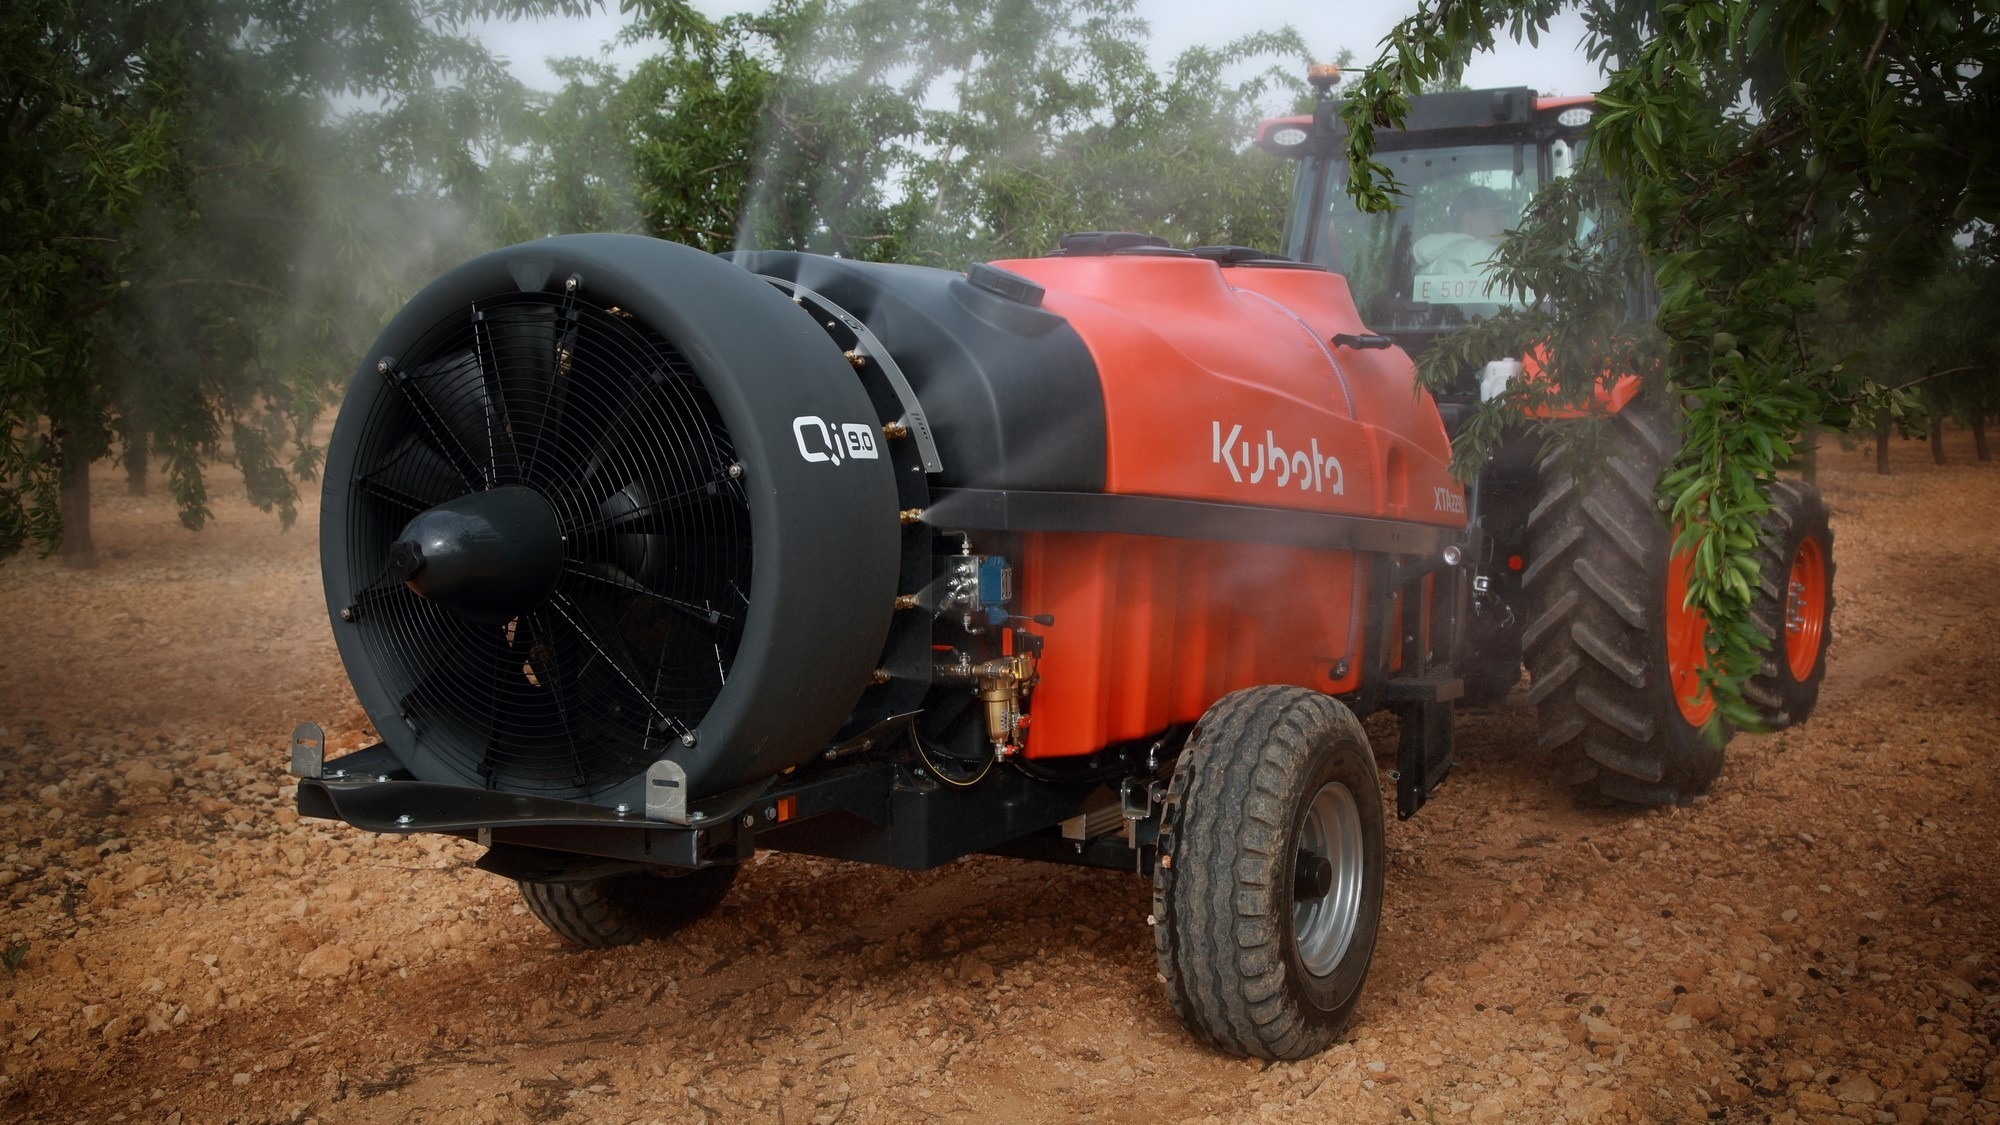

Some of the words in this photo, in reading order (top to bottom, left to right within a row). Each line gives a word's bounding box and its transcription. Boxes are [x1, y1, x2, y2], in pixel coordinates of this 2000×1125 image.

[1422, 281, 1431, 299] E
[792, 415, 845, 467] Qi
[847, 431, 874, 451] 9.0
[1212, 421, 1344, 496] Kubota
